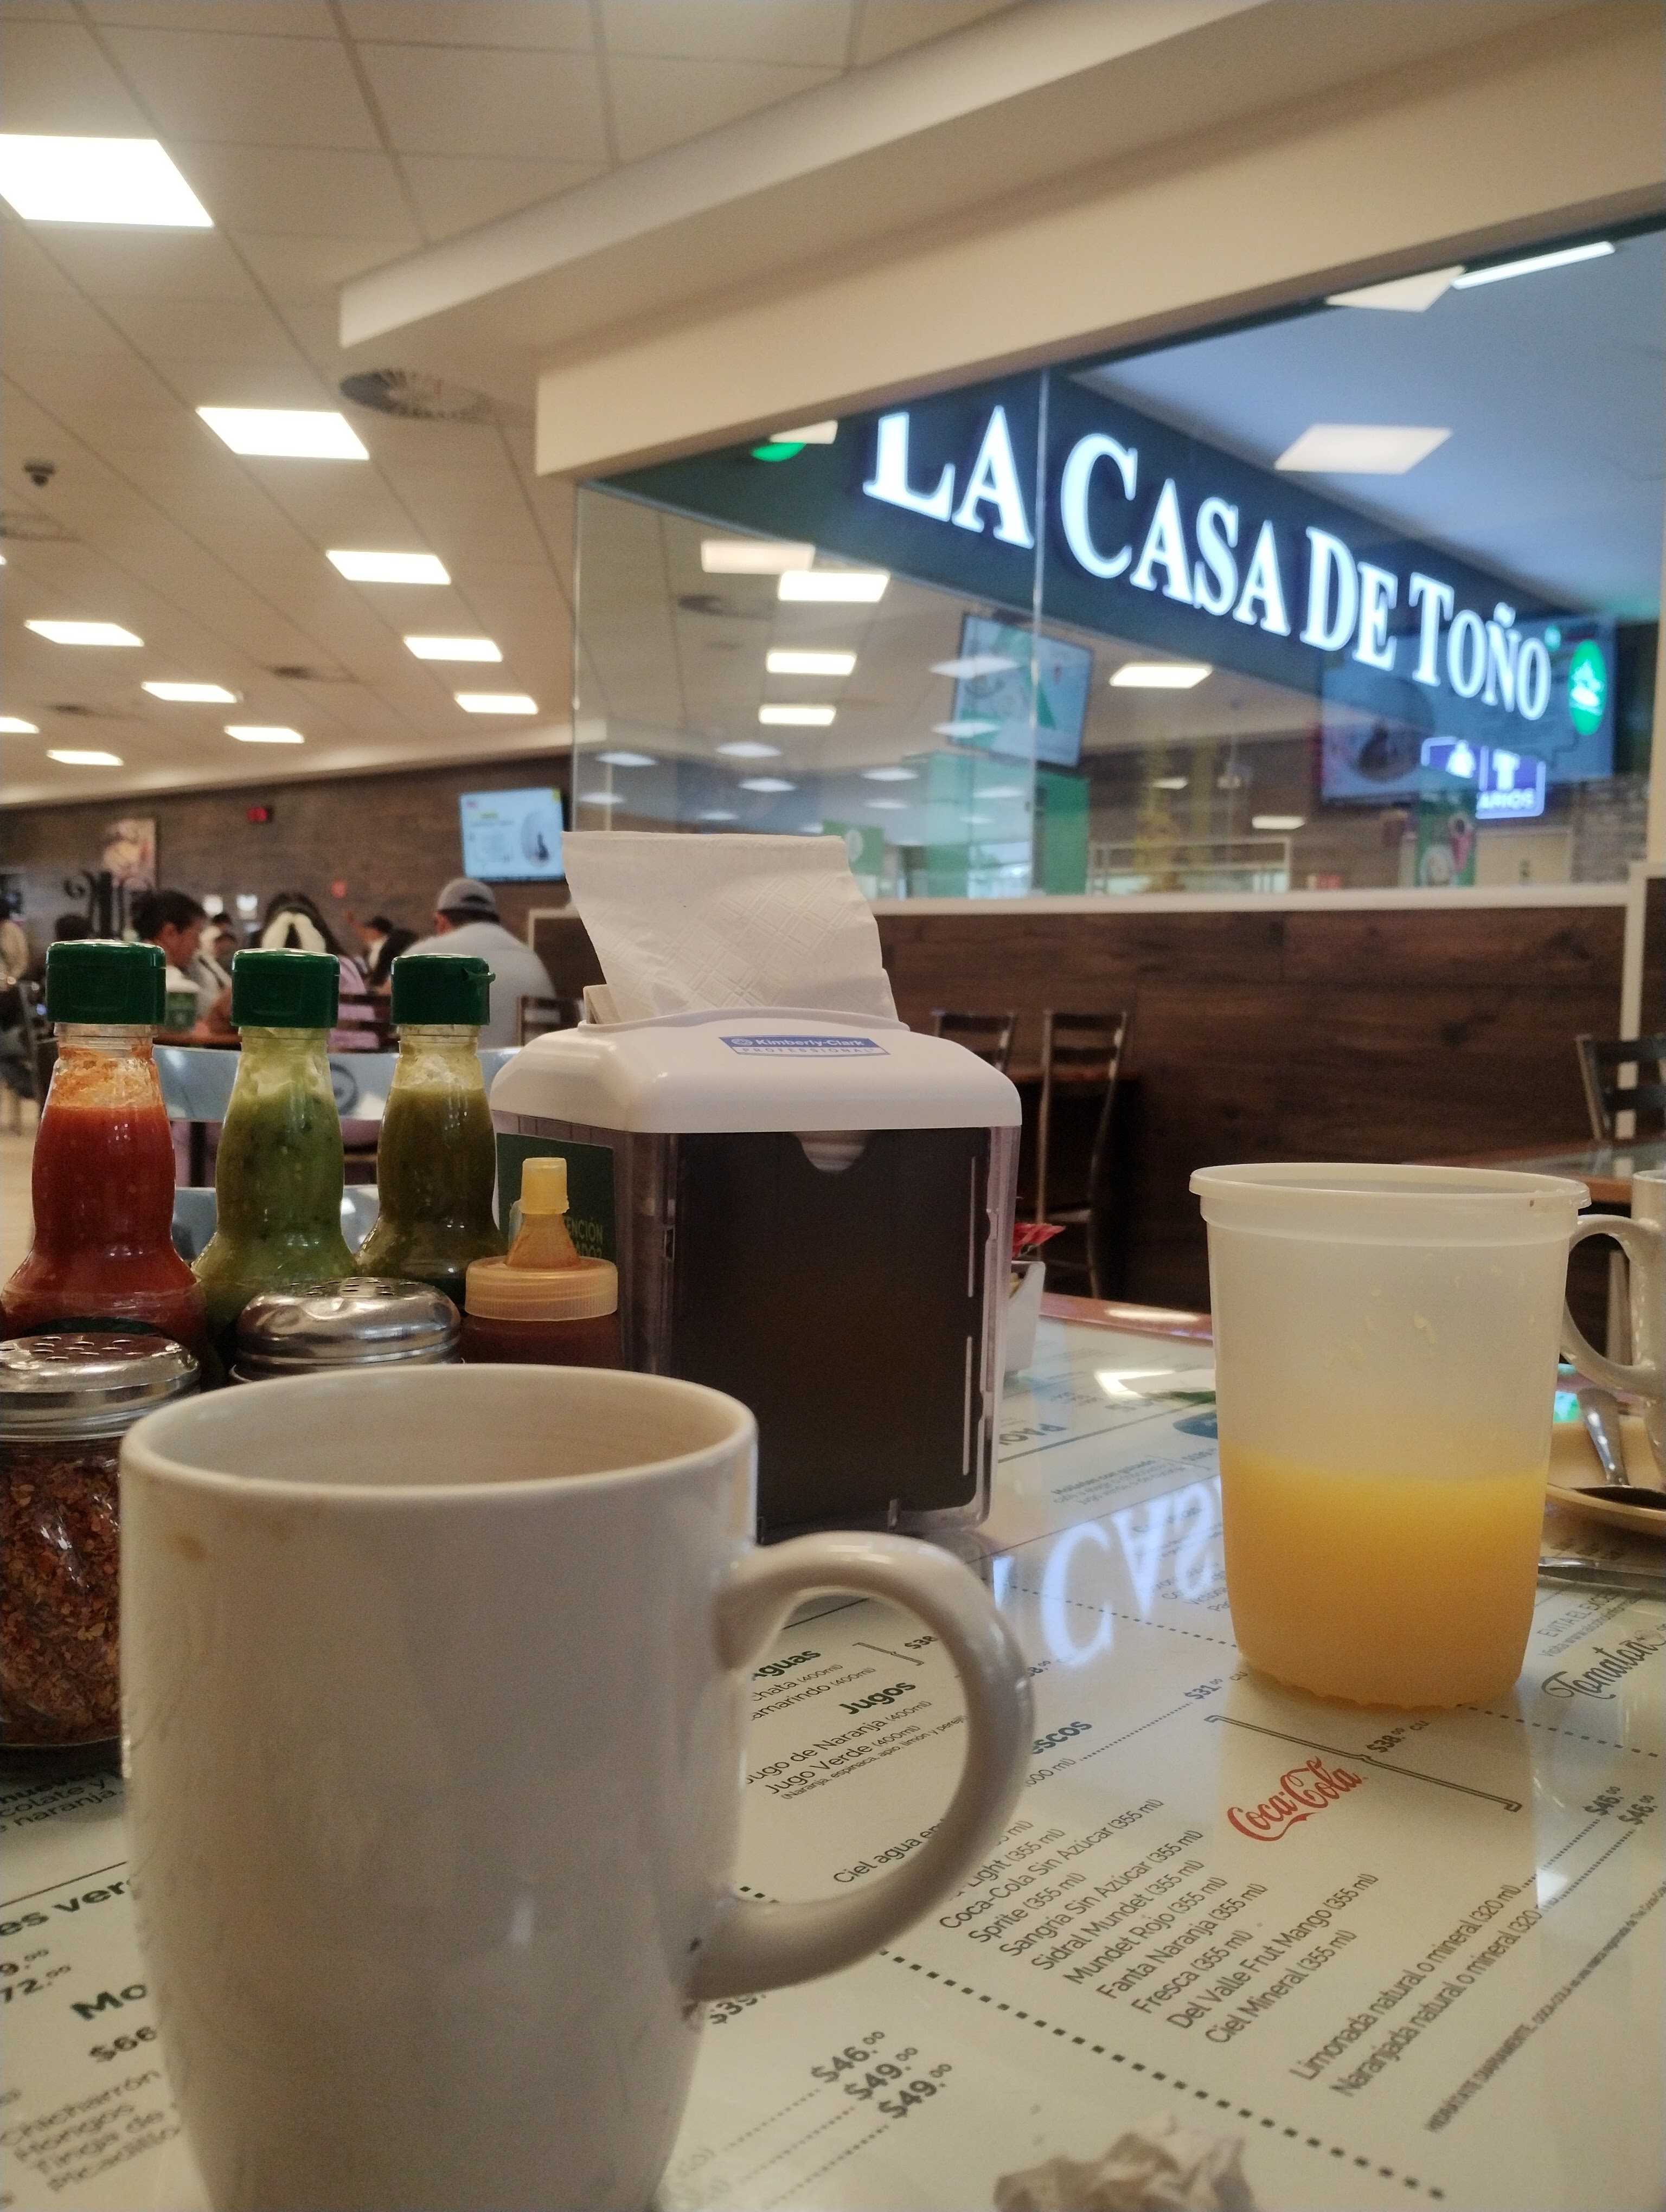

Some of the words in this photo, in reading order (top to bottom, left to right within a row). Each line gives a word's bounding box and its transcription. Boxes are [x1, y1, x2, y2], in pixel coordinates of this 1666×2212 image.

[862, 406, 1034, 549] LA
[1060, 433, 1291, 637] CASA
[1299, 526, 1399, 672] DE
[1409, 570, 1552, 721] TOÑO
[755, 1039, 863, 1047] Kimberly-Clark
[838, 1682, 917, 1715] Jugos
[764, 1770, 816, 1795] Jugo
[810, 1745, 874, 1771] Verde
[790, 1748, 818, 1763] de
[812, 1718, 888, 1751] Naranja
[834, 1861, 878, 1883] Ciel
[874, 1838, 923, 1863] agua
[939, 1874, 1037, 1929] Coca-Cola
[1028, 1857, 1063, 1876] Sin
[1107, 1810, 1143, 1830] (355
[1004, 1841, 1042, 1862] (355
[1064, 1895, 1101, 1915] Sin
[1145, 1843, 1182, 1863] (355
[967, 1908, 1029, 1944] Sprite
[1022, 1887, 1062, 1910] (355
[1031, 1932, 1093, 1971] Sidral
[1080, 1893, 1155, 1937] Mundet
[1144, 1873, 1183, 1895] (355
[1063, 1935, 1142, 1985] Mundet
[1128, 1912, 1176, 1940] Rojo
[1167, 1891, 1206, 1915] (355
[1095, 1962, 1158, 1999] Fanta
[1144, 1919, 1219, 1965] Naranja
[1208, 1898, 1246, 1921] (355
[1131, 1970, 1201, 2015] Fresca
[1190, 1945, 1231, 1972] (355
[1166, 2001, 1213, 2029] Del
[1195, 1970, 1252, 2003] Valle
[1238, 1944, 1287, 1973] Frut
[1271, 1908, 1332, 1949] Mango
[1322, 1887, 1359, 1910] (355
[1204, 2013, 1252, 2043] Ciel
[1236, 1967, 1310, 2018] Mineral
[1296, 1945, 1336, 1972] (355
[1409, 1980, 1467, 2029] natural
[1456, 1973, 1476, 1985] o
[1466, 1930, 1522, 1976] mineral
[1288, 2010, 1380, 2081] Limonada
[1368, 1968, 1427, 2016] natural
[1416, 1962, 1436, 1973] o
[1426, 1919, 1483, 1964] mineral
